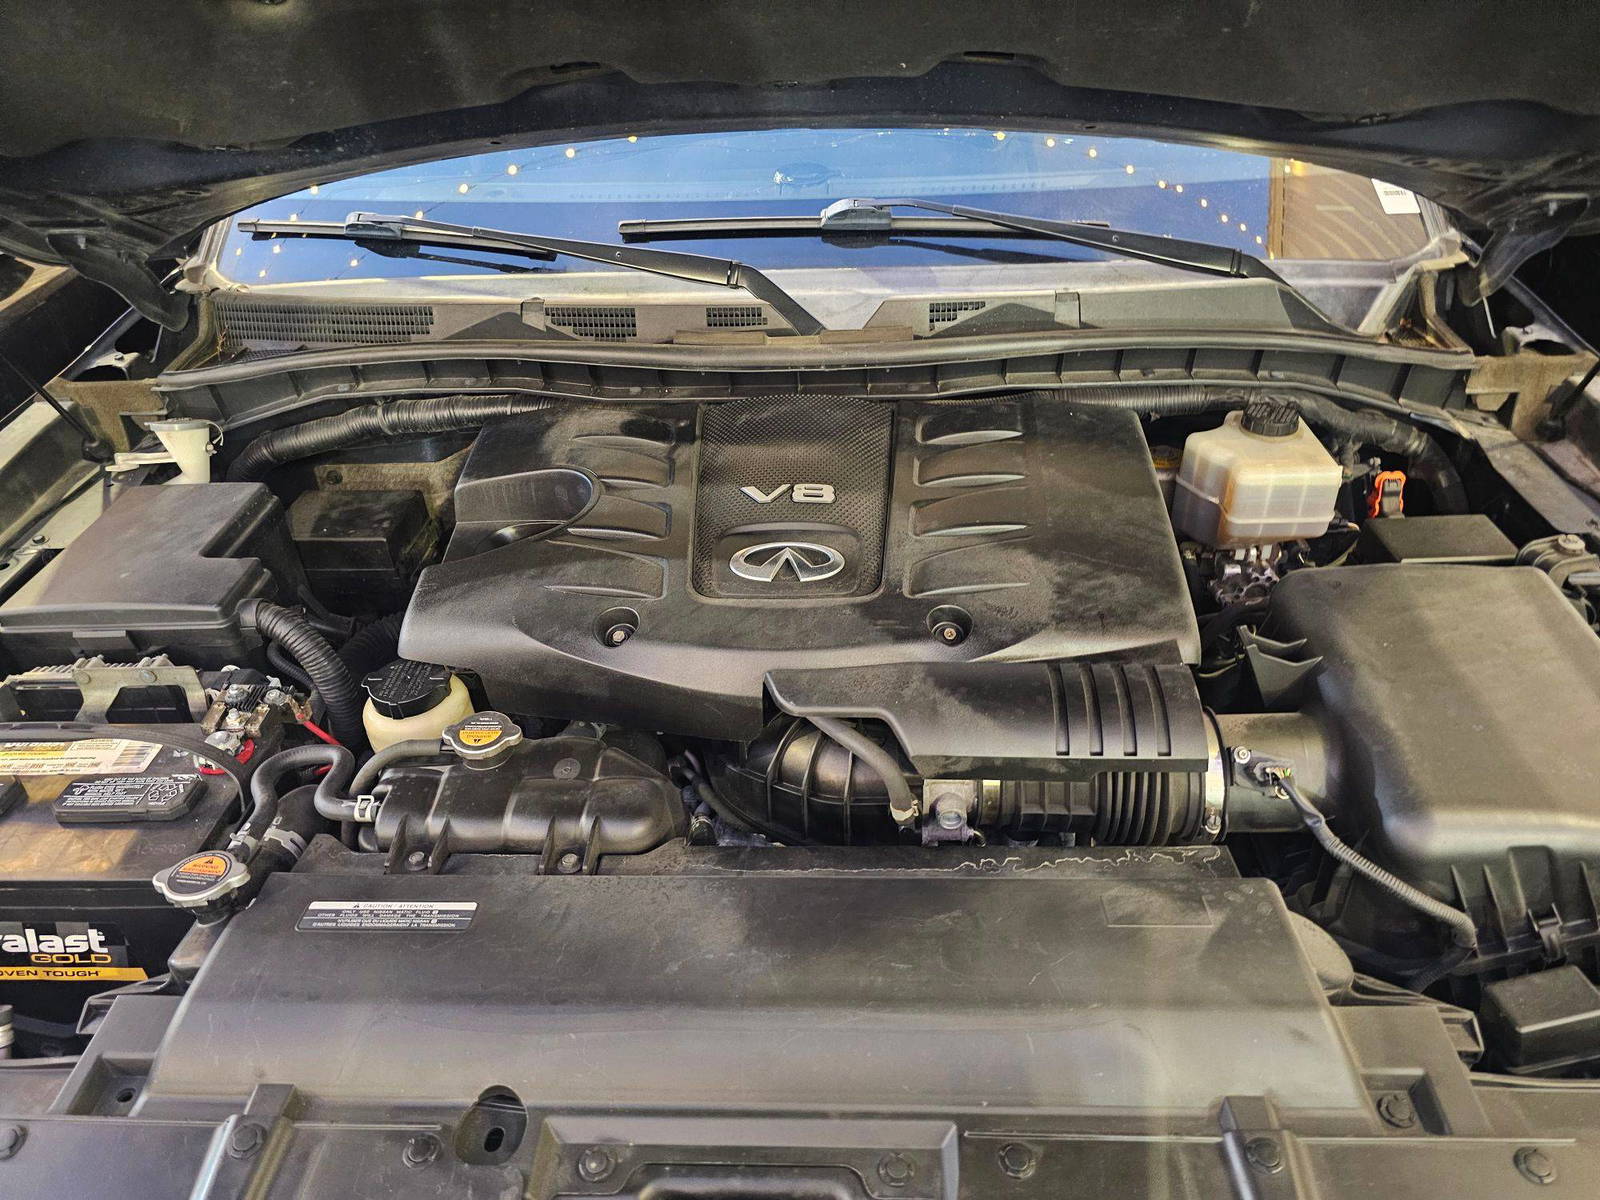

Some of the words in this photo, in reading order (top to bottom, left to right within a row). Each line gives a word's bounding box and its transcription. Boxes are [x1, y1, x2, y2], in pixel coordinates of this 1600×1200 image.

[740, 483, 837, 504] V8
[0, 928, 109, 953] alast
[30, 953, 112, 964] GOLD
